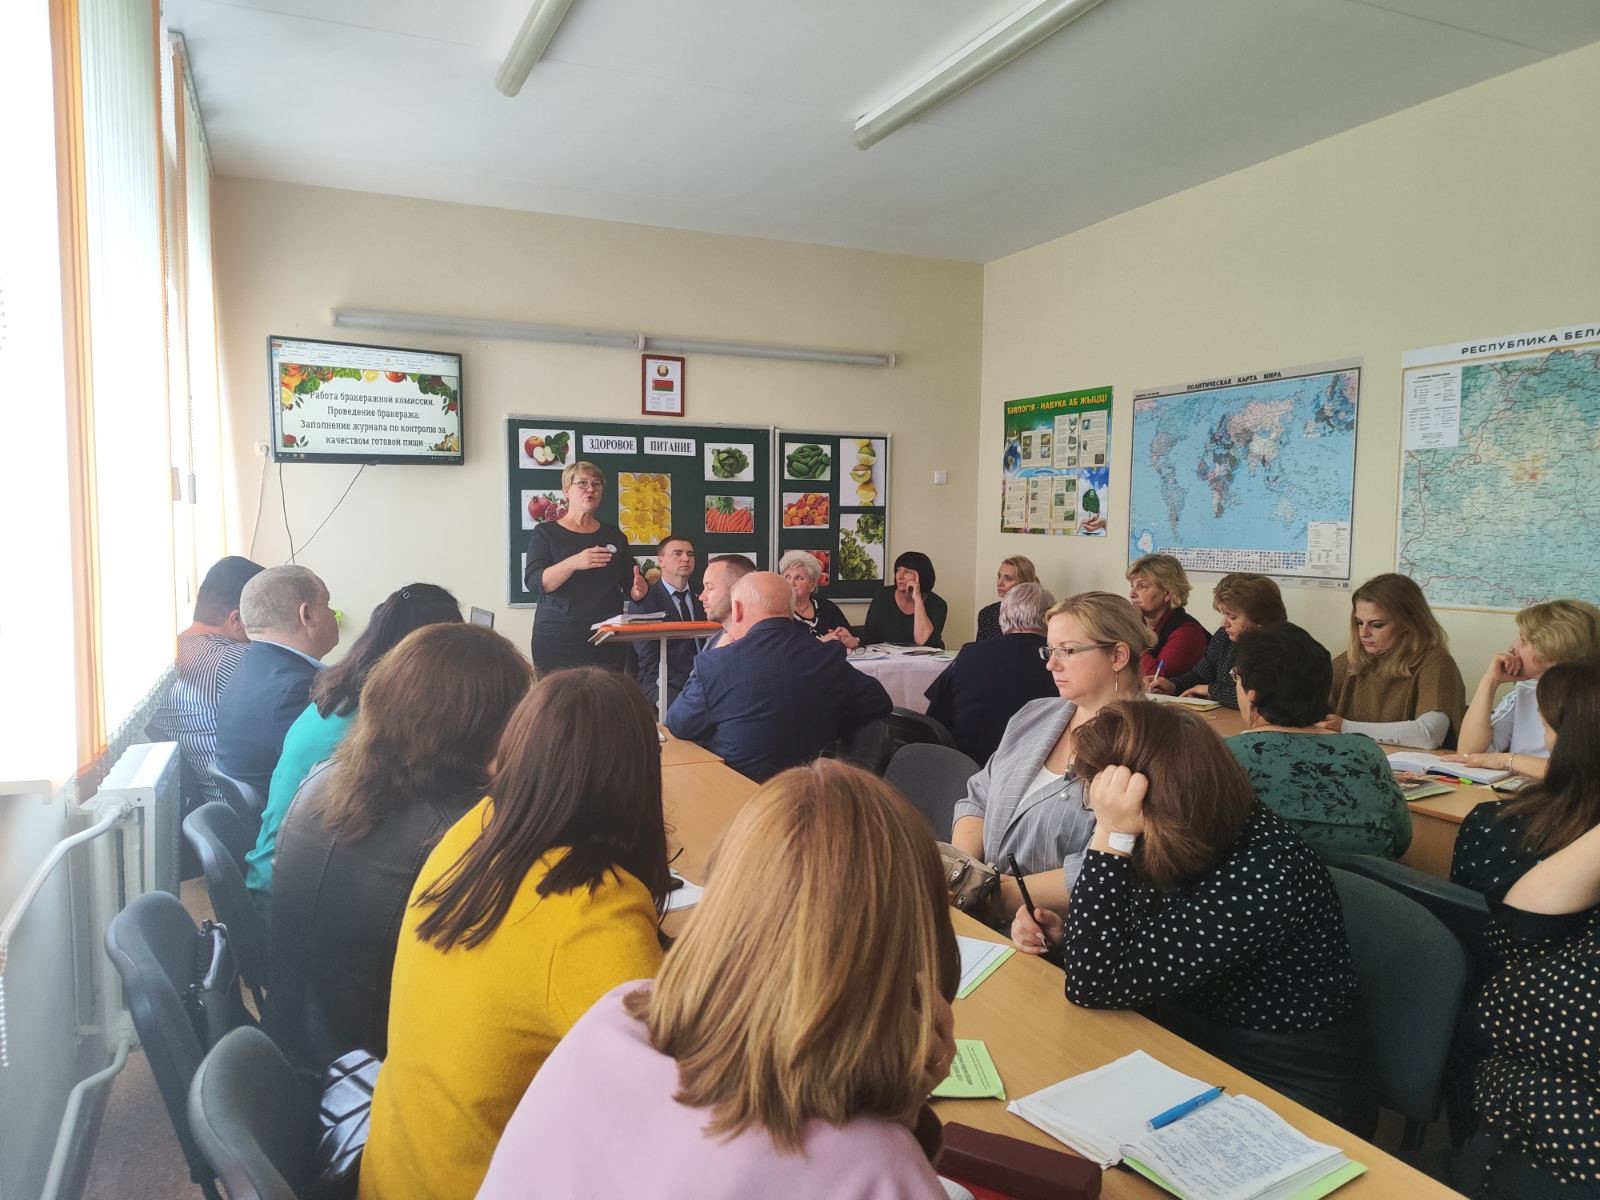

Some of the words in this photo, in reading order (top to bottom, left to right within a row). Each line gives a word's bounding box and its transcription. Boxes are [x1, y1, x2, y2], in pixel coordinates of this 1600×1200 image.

[1461, 334, 1559, 355] РЕСПУБЛИКА
[1186, 378, 1232, 391] ПОЛИТИЧЕСКАЯ
[1237, 374, 1258, 383] КАРТА
[1263, 371, 1282, 380] МИРА
[310, 391, 339, 401] Работа
[340, 392, 394, 404] бракеражной
[1040, 399, 1067, 410] НАВУКА
[1069, 397, 1078, 406] АБ
[327, 406, 376, 418] Проведение
[300, 420, 351, 430] Заполнение
[352, 423, 388, 434] журнала
[389, 424, 400, 432] по
[400, 425, 437, 435] контролю
[437, 426, 446, 434] за
[325, 436, 370, 445] качеством
[371, 437, 401, 446] готовой
[589, 438, 635, 450] ЗДОРОВОЕ
[650, 440, 692, 453] ПИТАНИЕ
